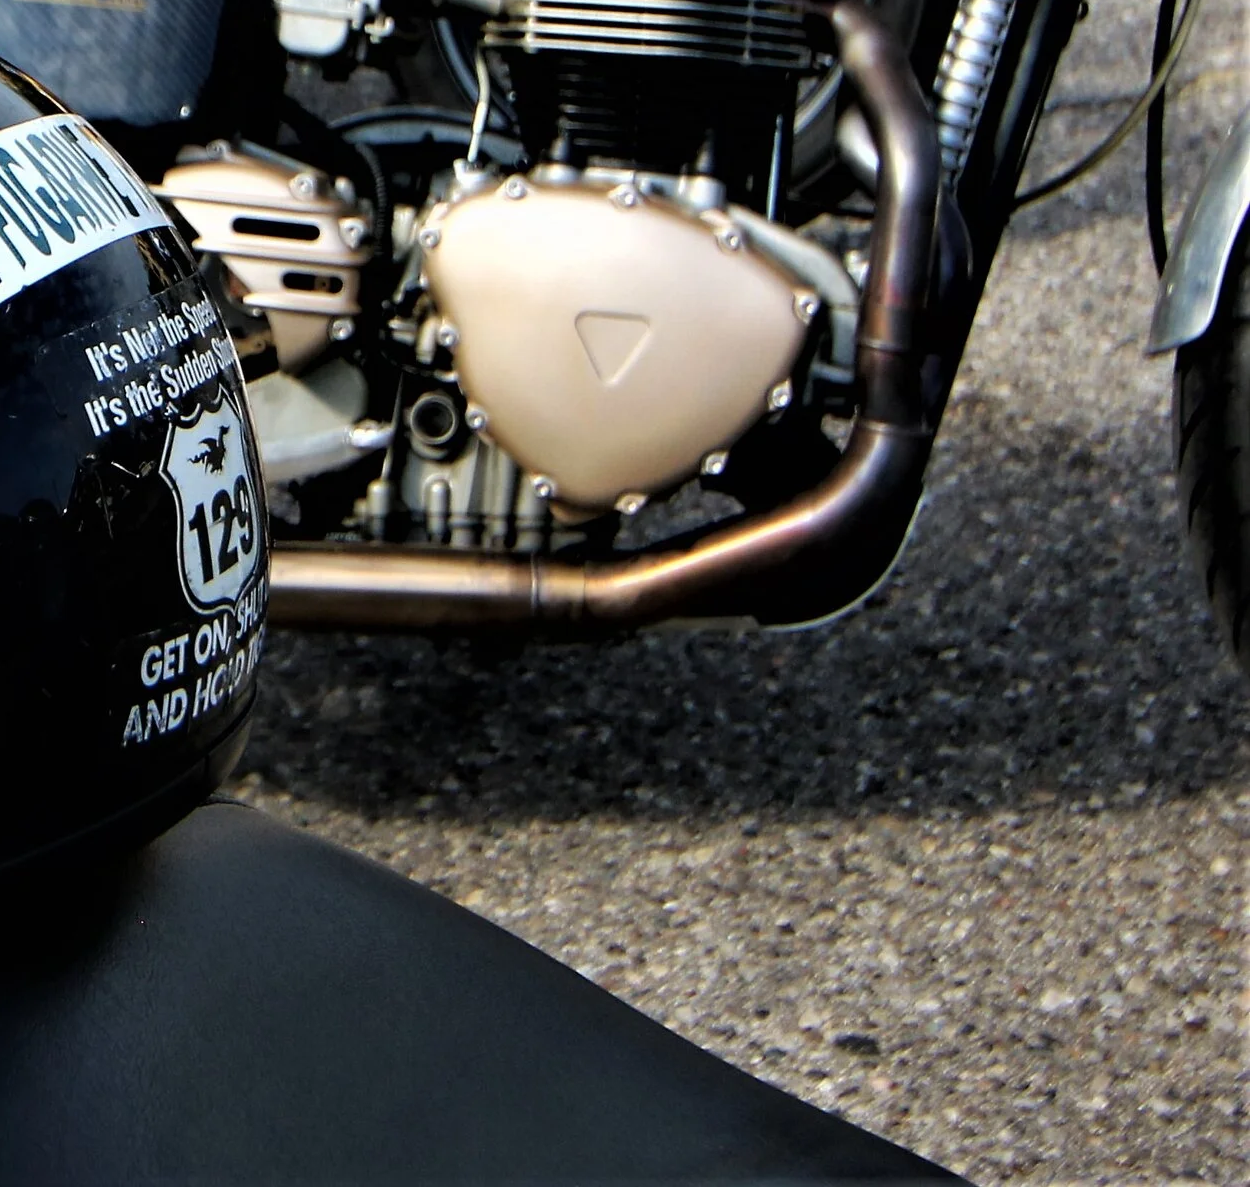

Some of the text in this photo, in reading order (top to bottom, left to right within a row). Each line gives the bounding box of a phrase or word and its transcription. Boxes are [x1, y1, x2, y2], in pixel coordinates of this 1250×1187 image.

[84, 342, 128, 382] It's
[122, 320, 165, 364] Not
[158, 313, 189, 347] the
[84, 396, 127, 437] It's
[124, 379, 164, 417] the
[160, 350, 218, 400] Sudden
[188, 474, 254, 584] 129
[140, 633, 190, 688] GET
[193, 613, 233, 665] ON,
[122, 687, 188, 748] AND
